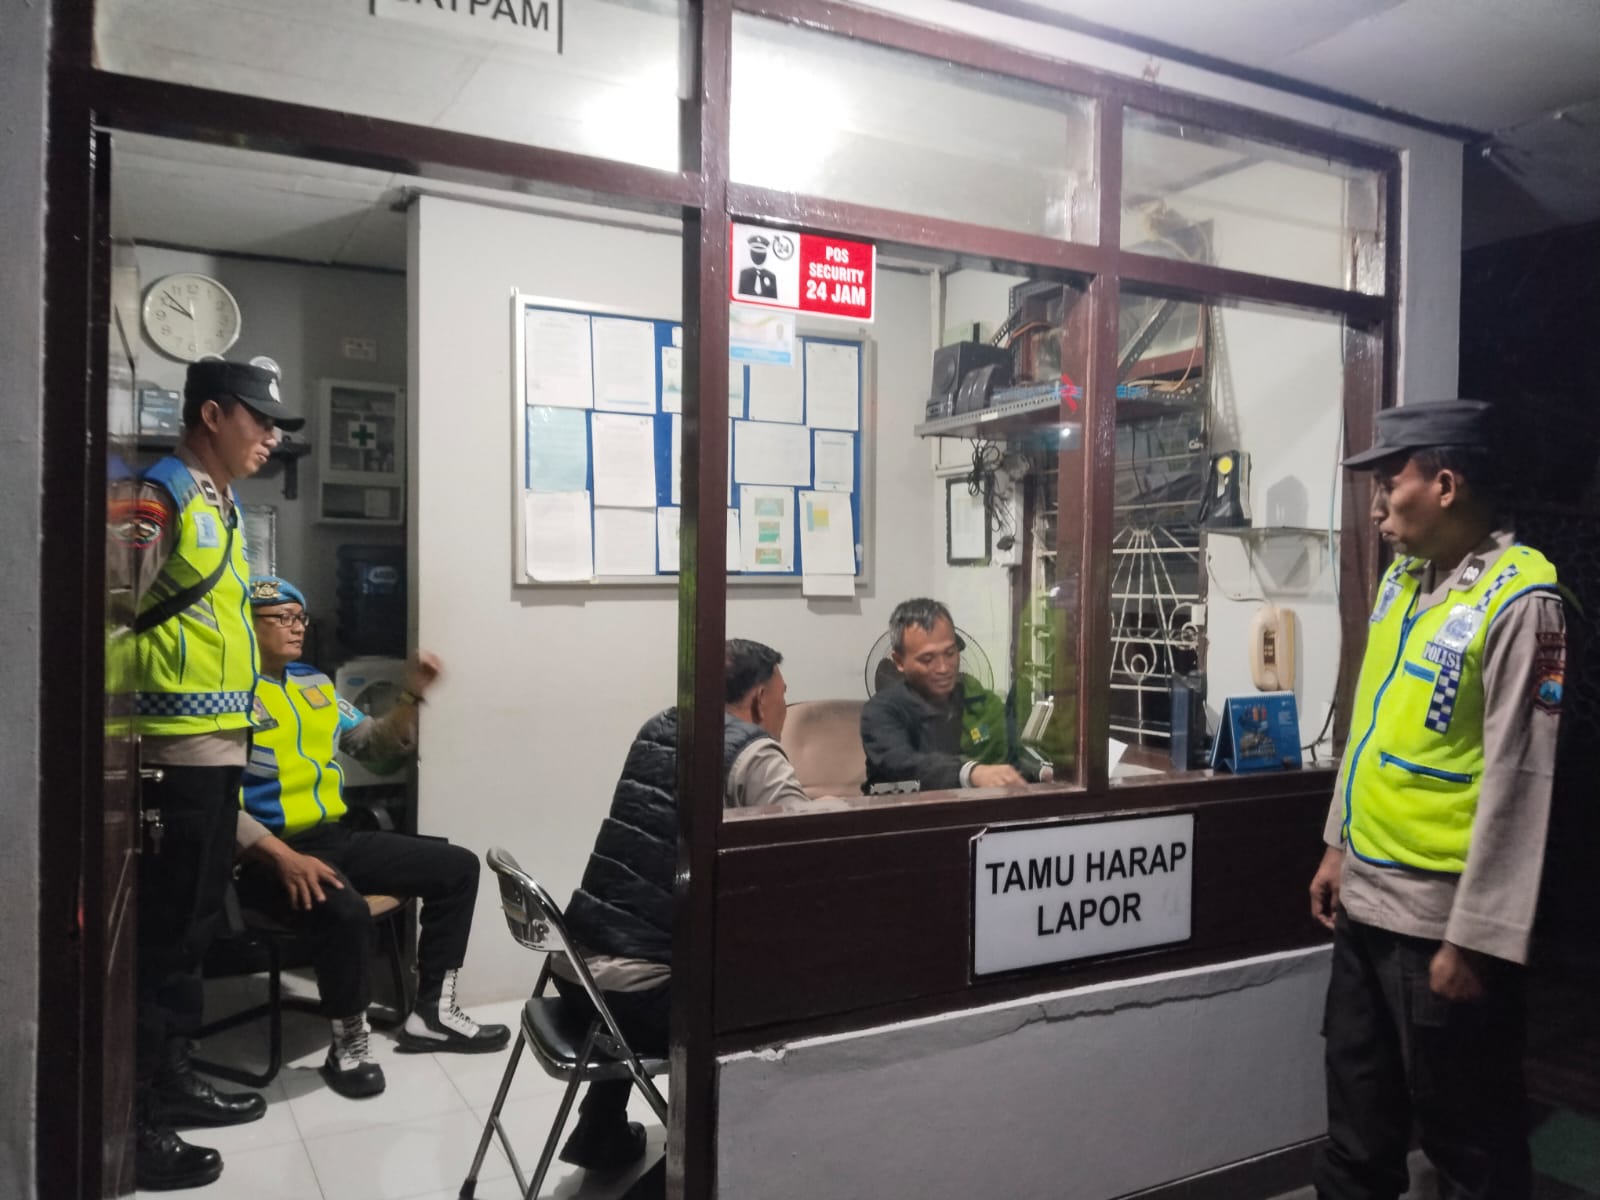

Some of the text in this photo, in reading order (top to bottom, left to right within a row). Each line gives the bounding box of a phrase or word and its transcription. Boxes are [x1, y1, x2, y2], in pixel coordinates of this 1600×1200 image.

[825, 245, 849, 263] POS
[808, 262, 865, 284] SECURITY
[806, 280, 866, 306] 24 JAM
[1423, 643, 1461, 671] POLISI
[985, 842, 1187, 895] TAMU HARAP
[1037, 892, 1142, 937] LAPOR
